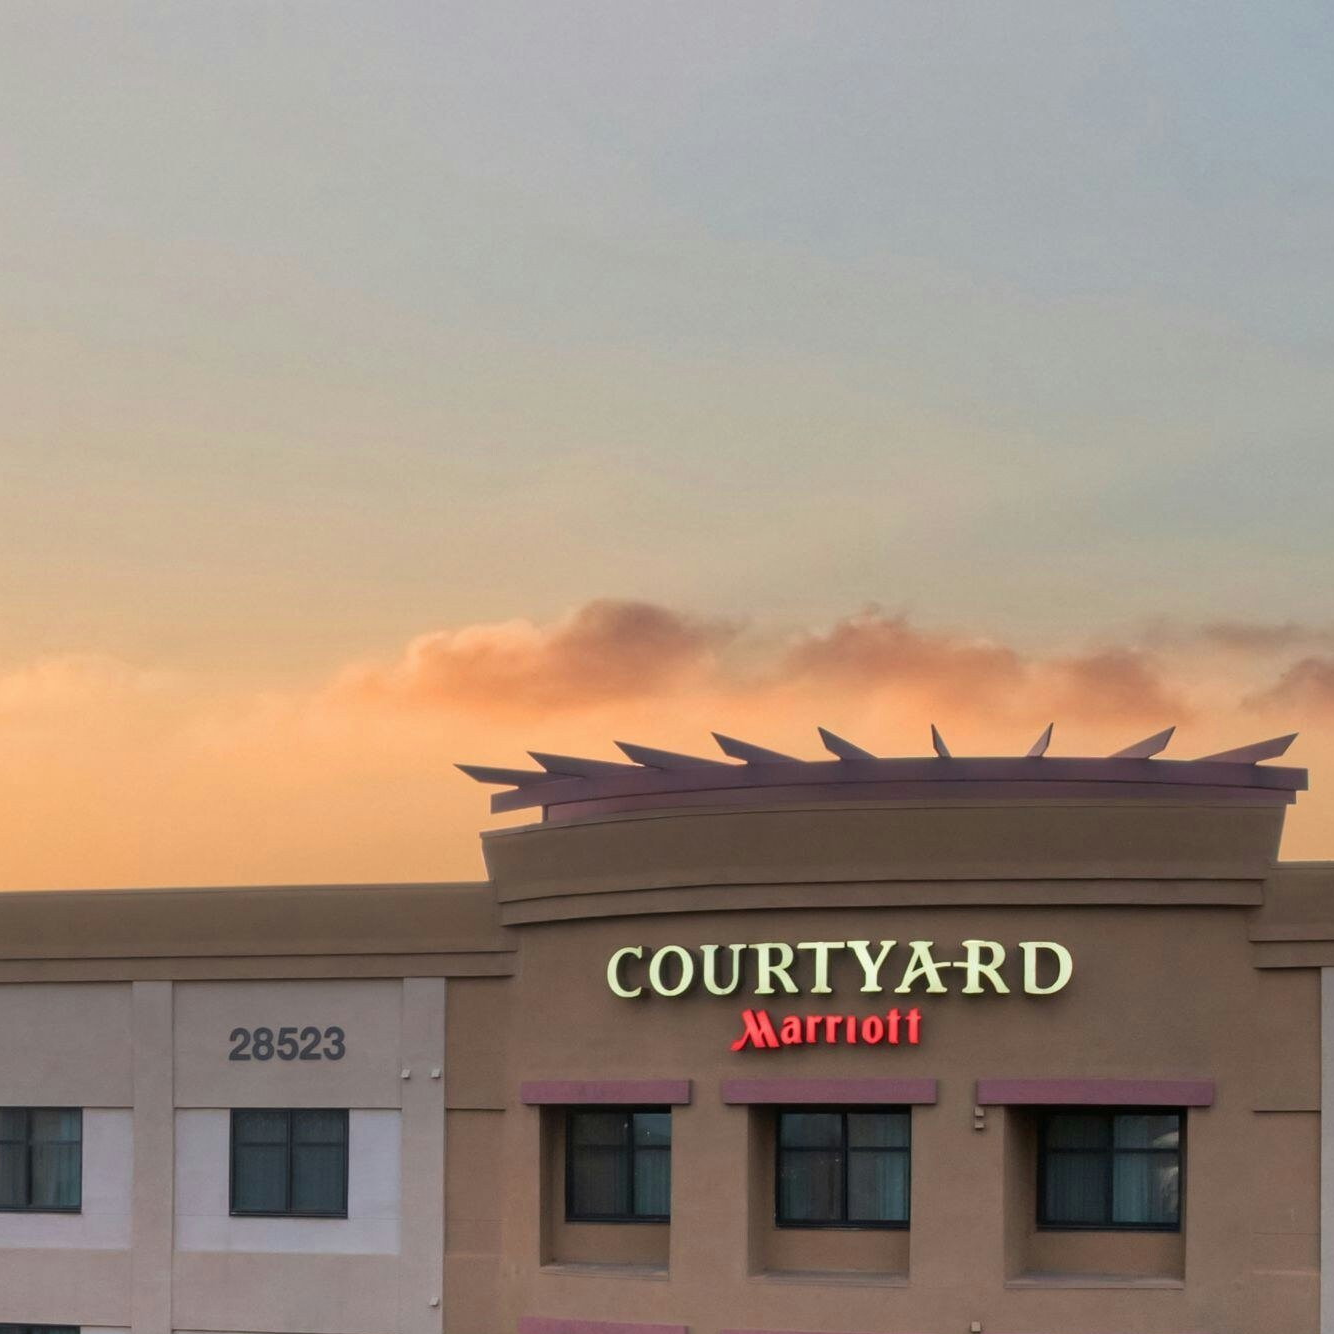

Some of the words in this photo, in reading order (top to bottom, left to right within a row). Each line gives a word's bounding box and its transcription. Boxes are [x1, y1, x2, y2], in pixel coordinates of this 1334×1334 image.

[606, 939, 1074, 998] COURTYARD
[228, 1026, 346, 1061] 28523
[730, 1007, 922, 1052] Marriott
